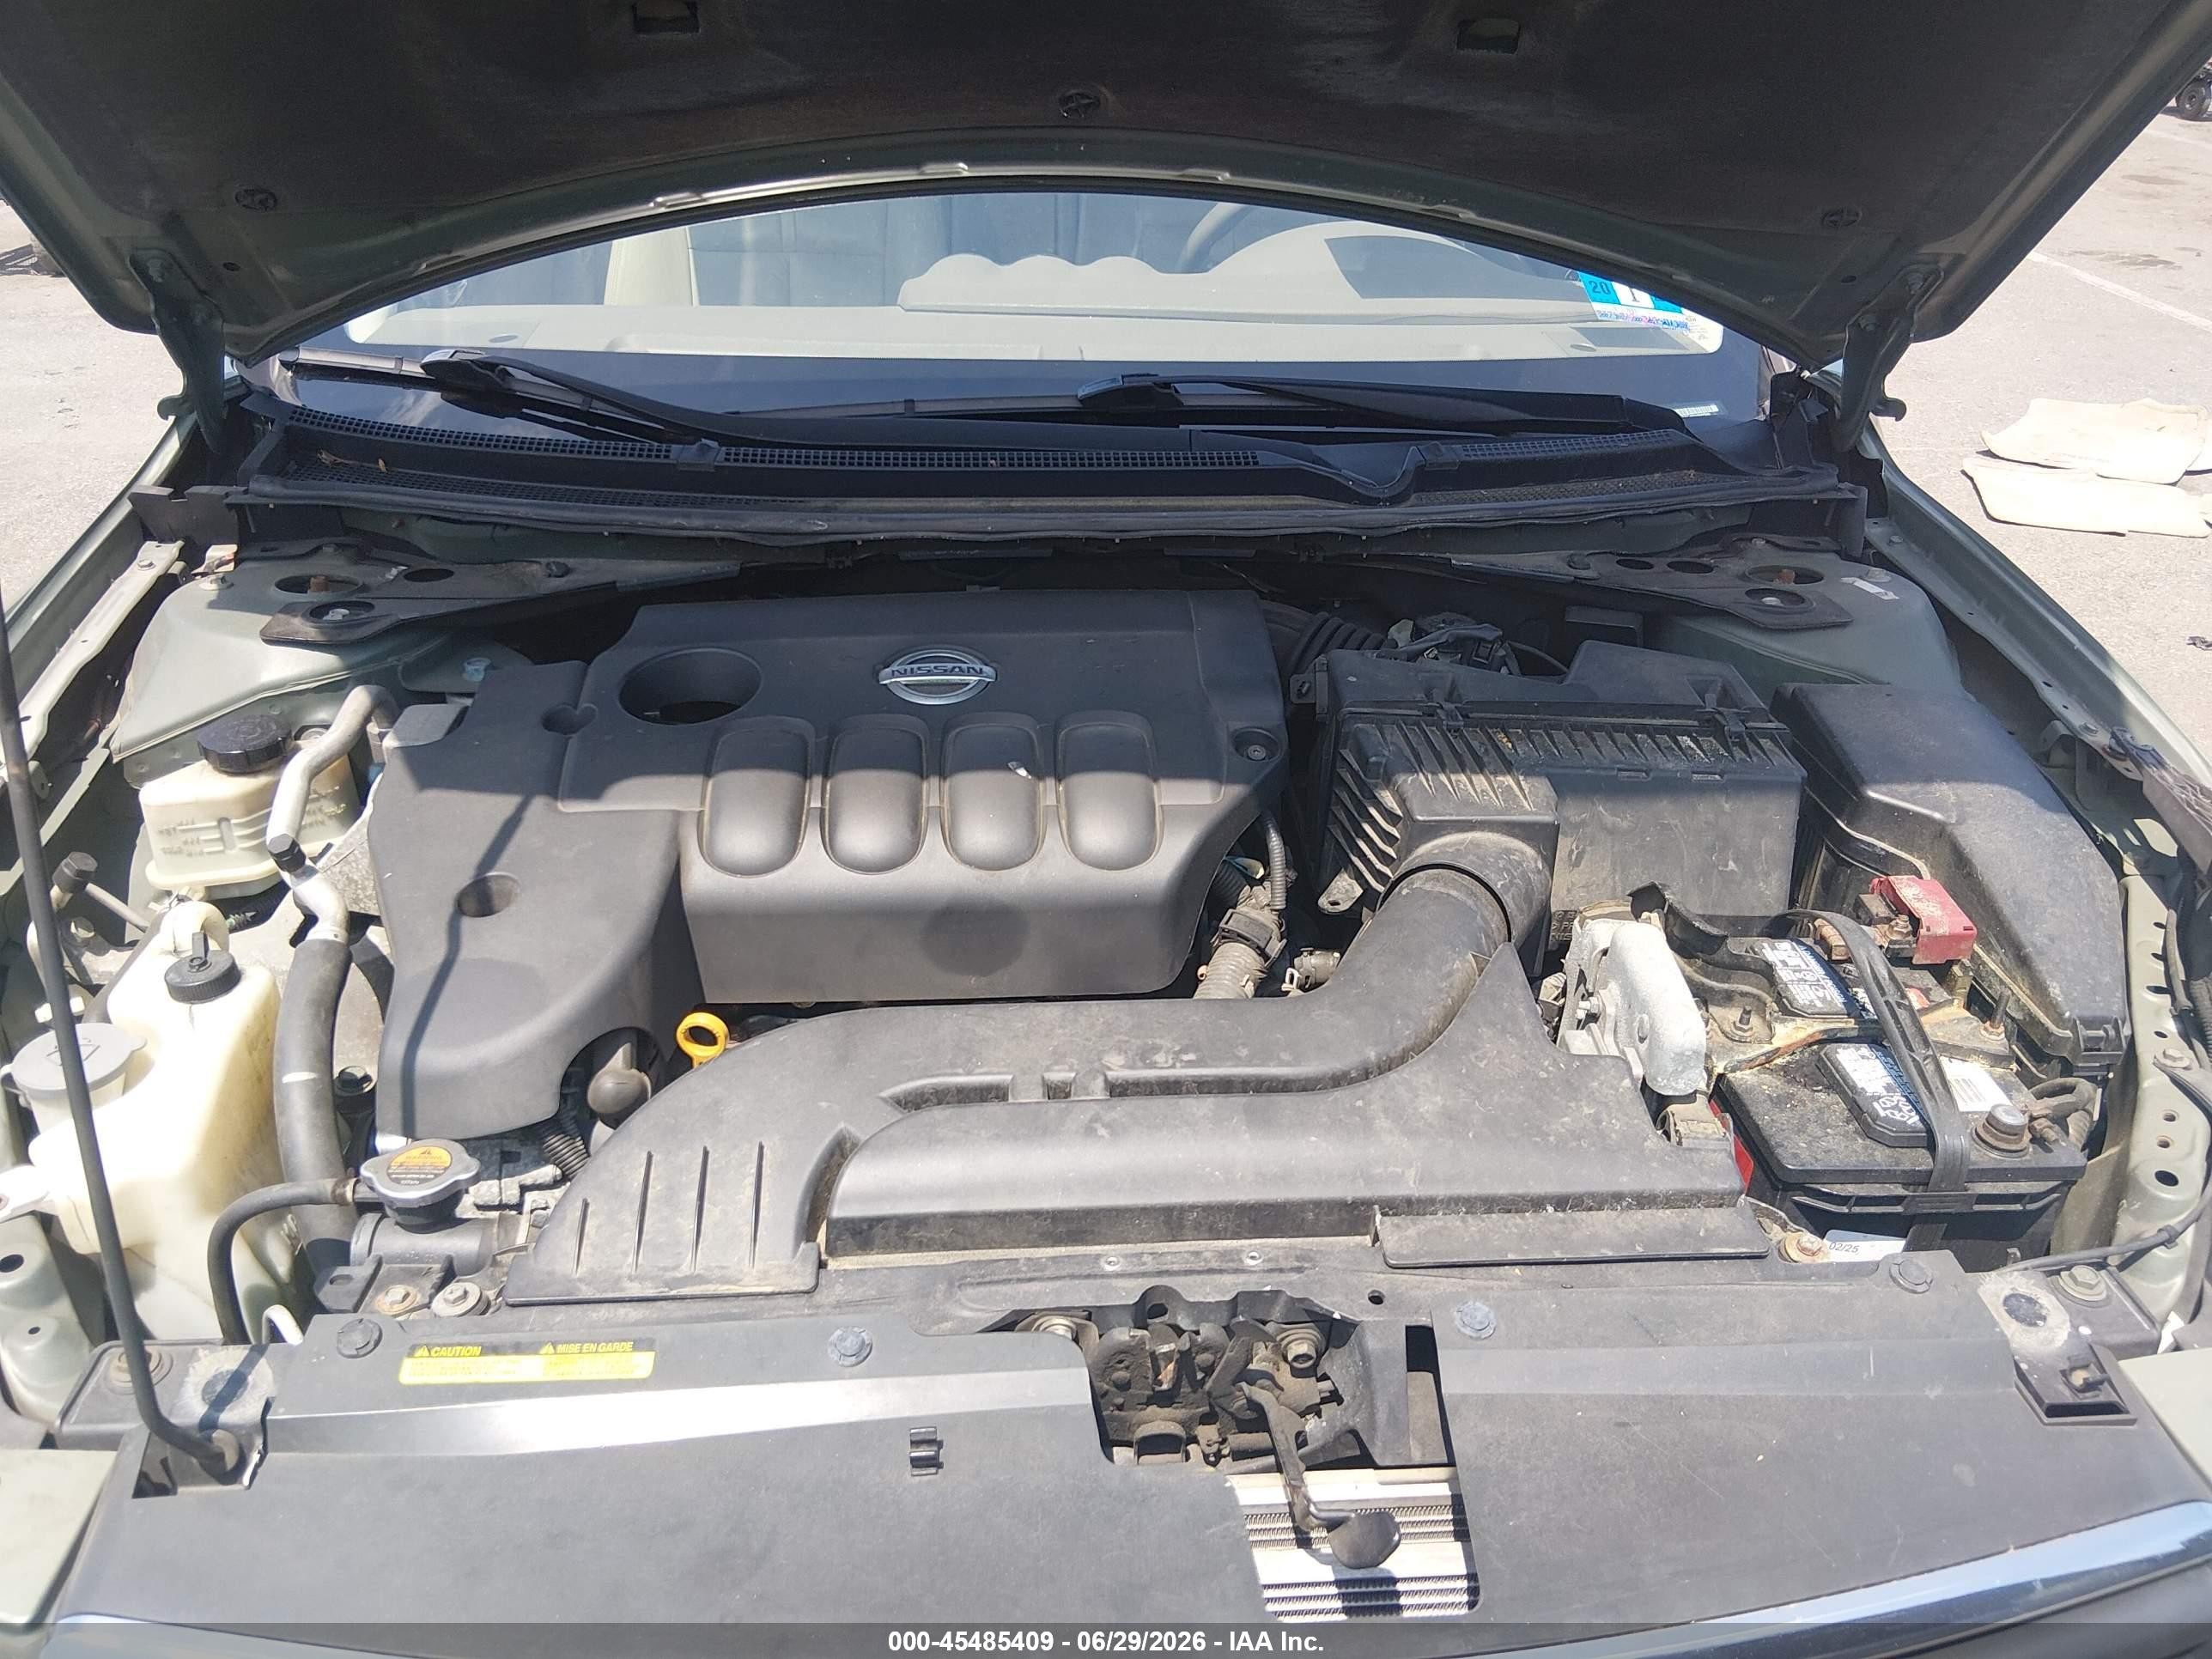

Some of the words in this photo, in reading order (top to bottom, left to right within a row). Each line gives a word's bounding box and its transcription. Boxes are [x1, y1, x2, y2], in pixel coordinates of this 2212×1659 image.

[1589, 281, 1611, 295] 20
[891, 665, 984, 677] NISSAN
[1828, 1242, 1861, 1254] 02/25
[430, 1346, 482, 1357] CAUTION
[556, 1343, 582, 1354] MISE
[582, 1342, 598, 1352] EN
[599, 1341, 634, 1352] GARDE
